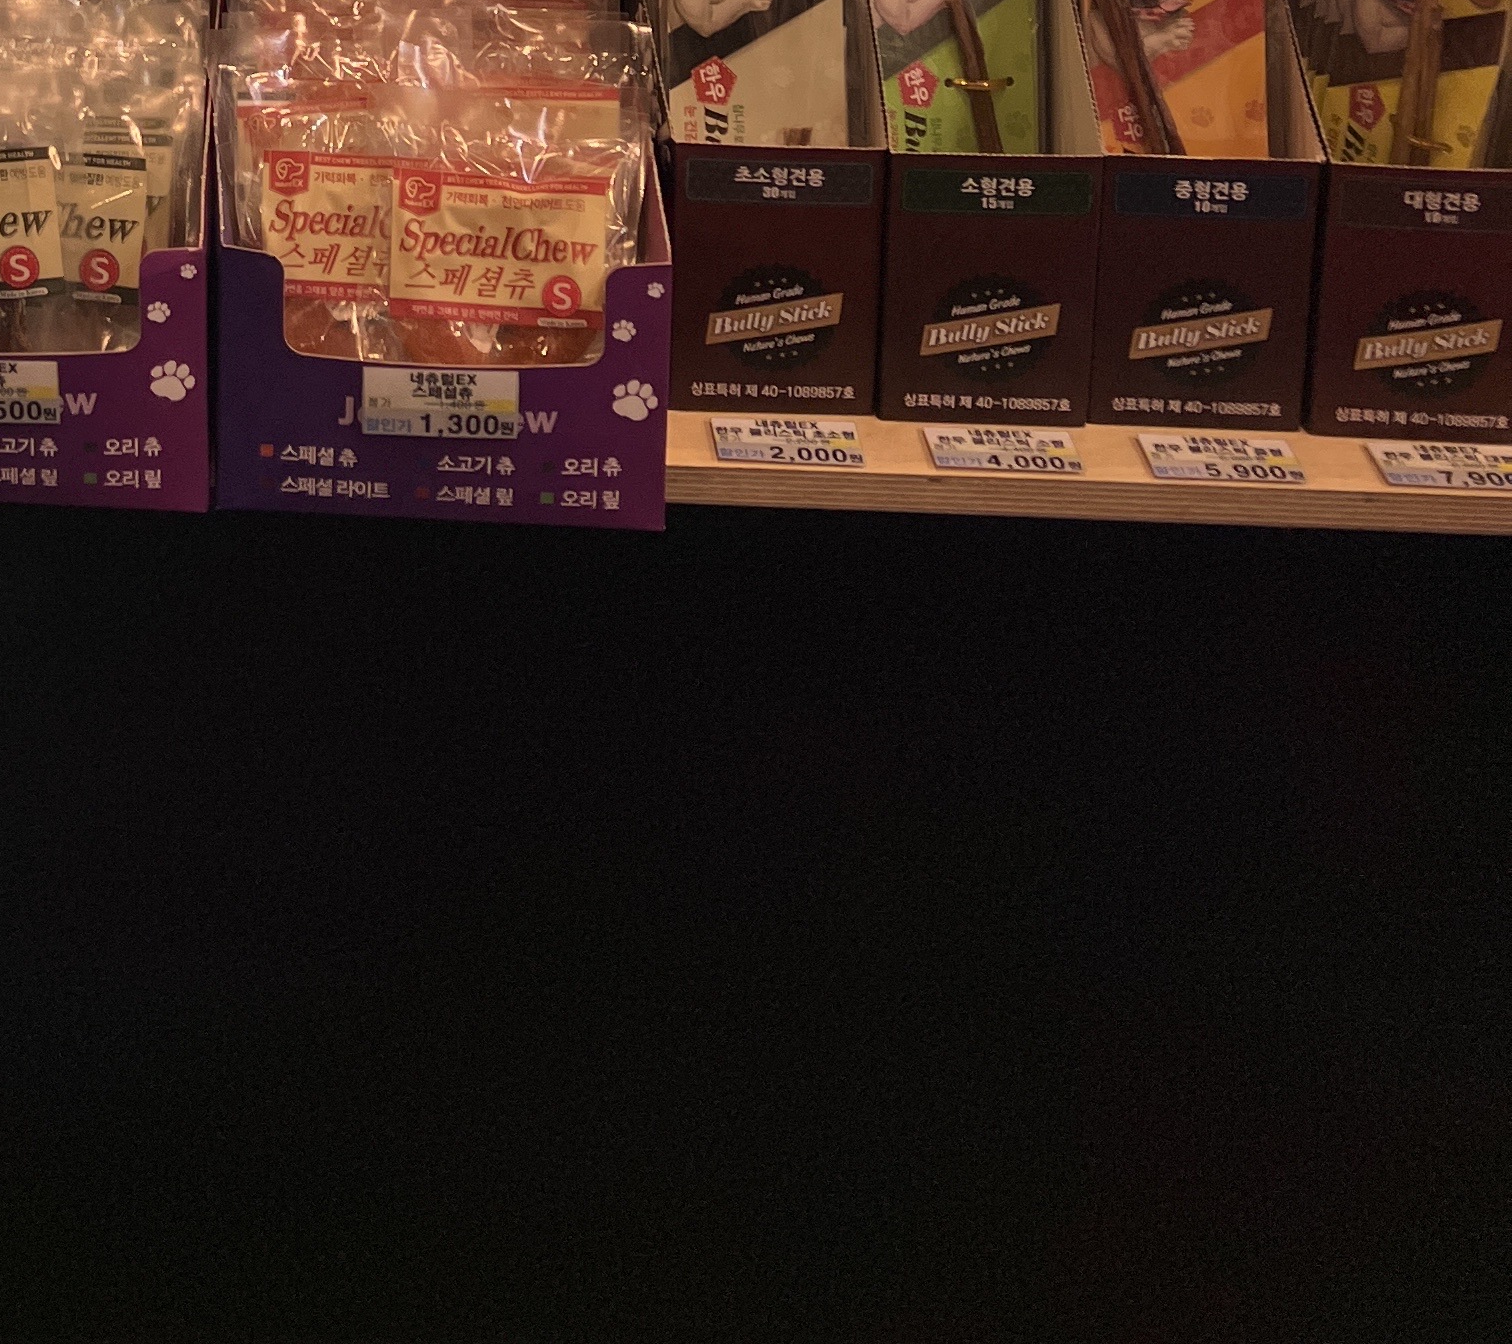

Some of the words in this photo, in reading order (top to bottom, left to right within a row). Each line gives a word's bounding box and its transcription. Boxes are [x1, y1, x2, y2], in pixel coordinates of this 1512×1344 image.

[734, 165, 826, 190] 초소형견용
[960, 176, 1035, 199] 소형견용
[399, 219, 599, 268] SpecialChew
[405, 263, 536, 301] 스페셜츄
[736, 289, 772, 305] Human
[773, 283, 805, 300] Grade
[714, 312, 776, 338] Bully
[778, 301, 834, 326] Stick
[928, 322, 990, 349] Bully
[994, 312, 1050, 336] Stick
[1137, 327, 1201, 353] Bully
[1203, 316, 1262, 340] Stick
[691, 381, 743, 399] 상표특허
[745, 382, 759, 399] 제
[761, 383, 857, 401] 40-1089857호
[904, 392, 956, 410] 상표특허
[959, 393, 973, 410] 제
[420, 414, 516, 438] 1,300원
[104, 438, 140, 457] 오리
[769, 444, 864, 465] 2,000원
[280, 477, 333, 498] 스페셜
[337, 479, 391, 500] 라이트
